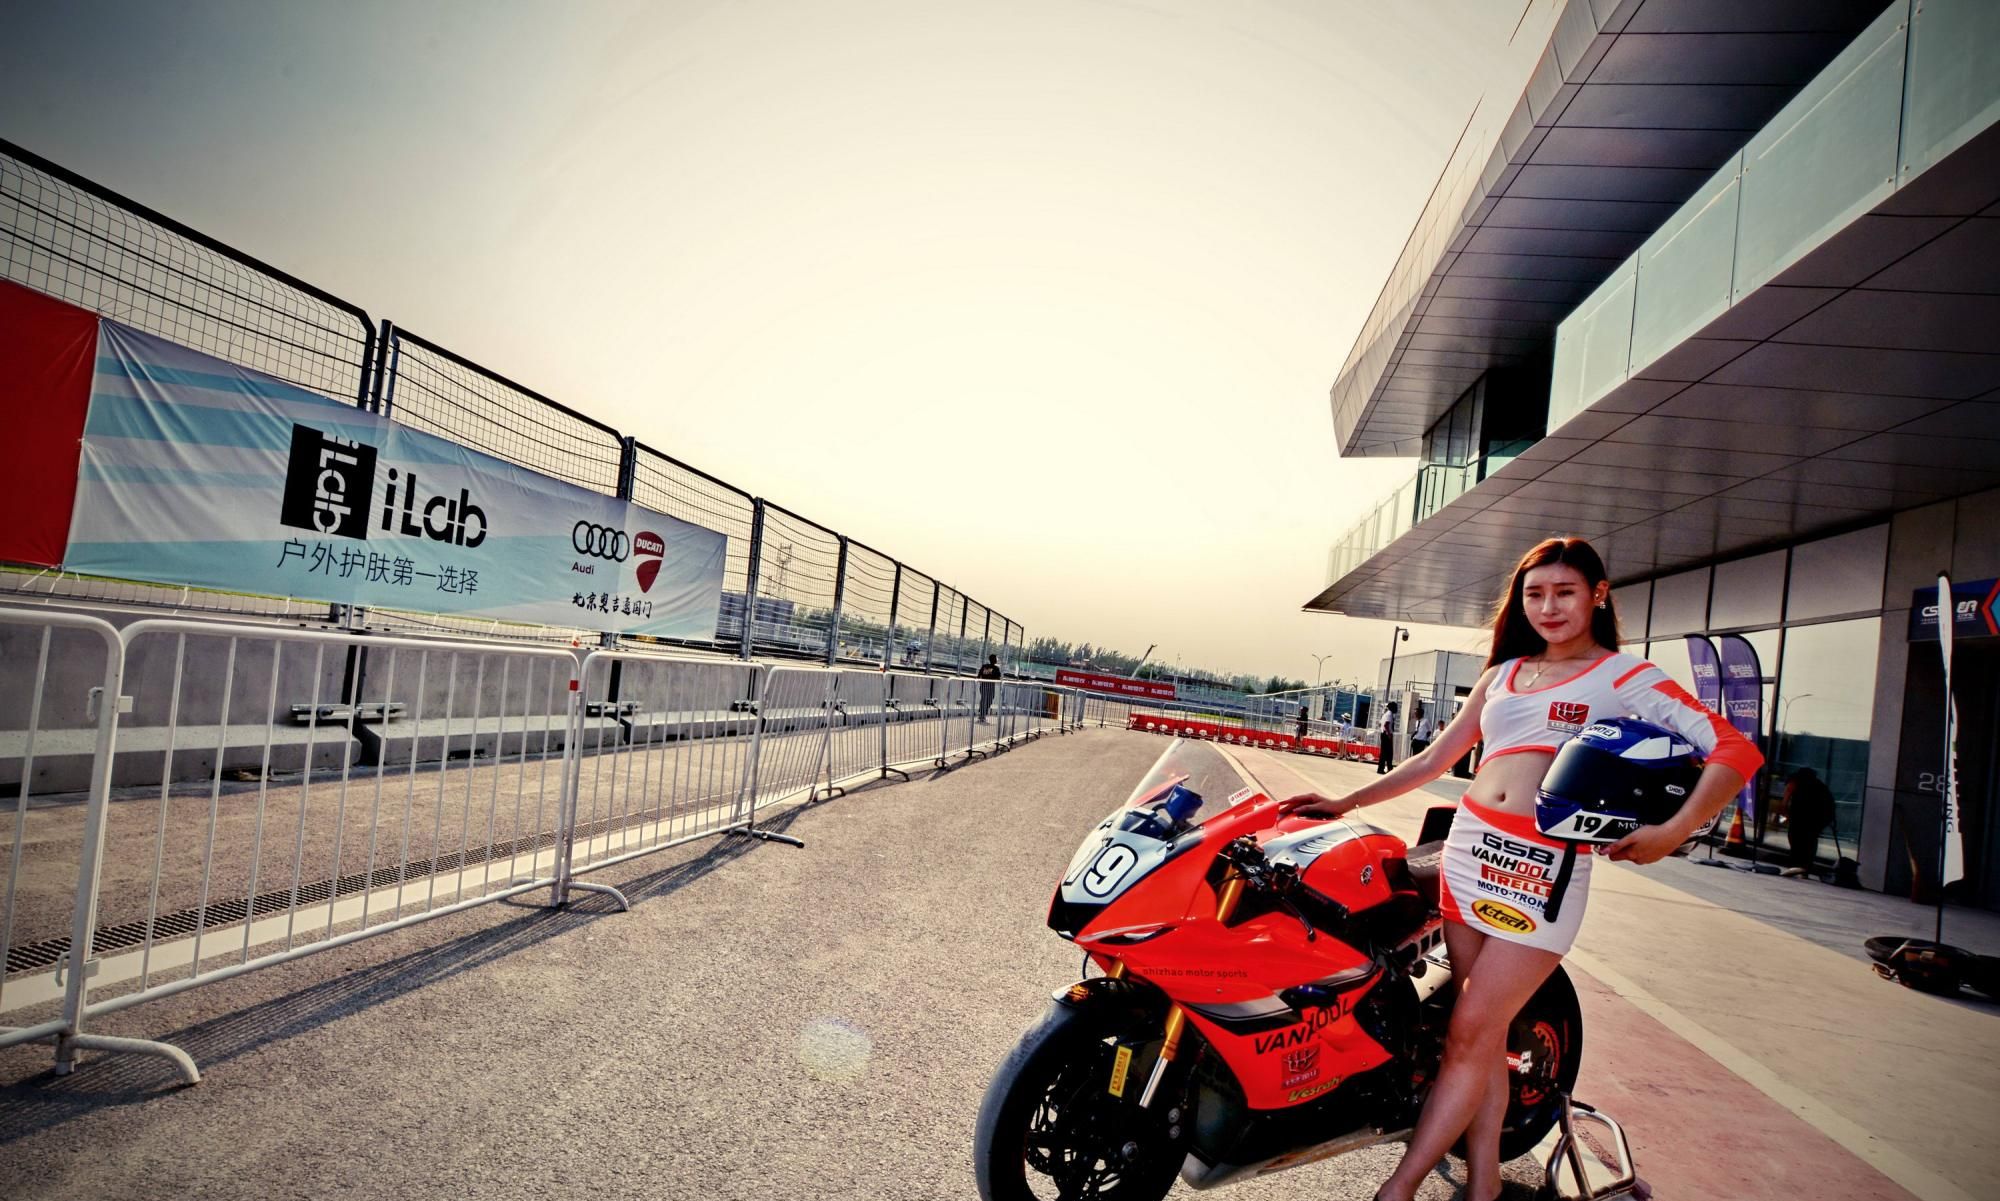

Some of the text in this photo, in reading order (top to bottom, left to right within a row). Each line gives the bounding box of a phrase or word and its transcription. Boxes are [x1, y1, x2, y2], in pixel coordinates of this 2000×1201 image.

[381, 467, 488, 548] iLab
[635, 538, 663, 553] DUCATI
[276, 537, 480, 596] 户外护肤第一选择
[571, 561, 595, 575] Audi
[1573, 814, 1603, 834] 19
[1471, 845, 1554, 882] VANHOOL
[1482, 832, 1555, 866] GSB
[1481, 863, 1553, 898] PIRELLI
